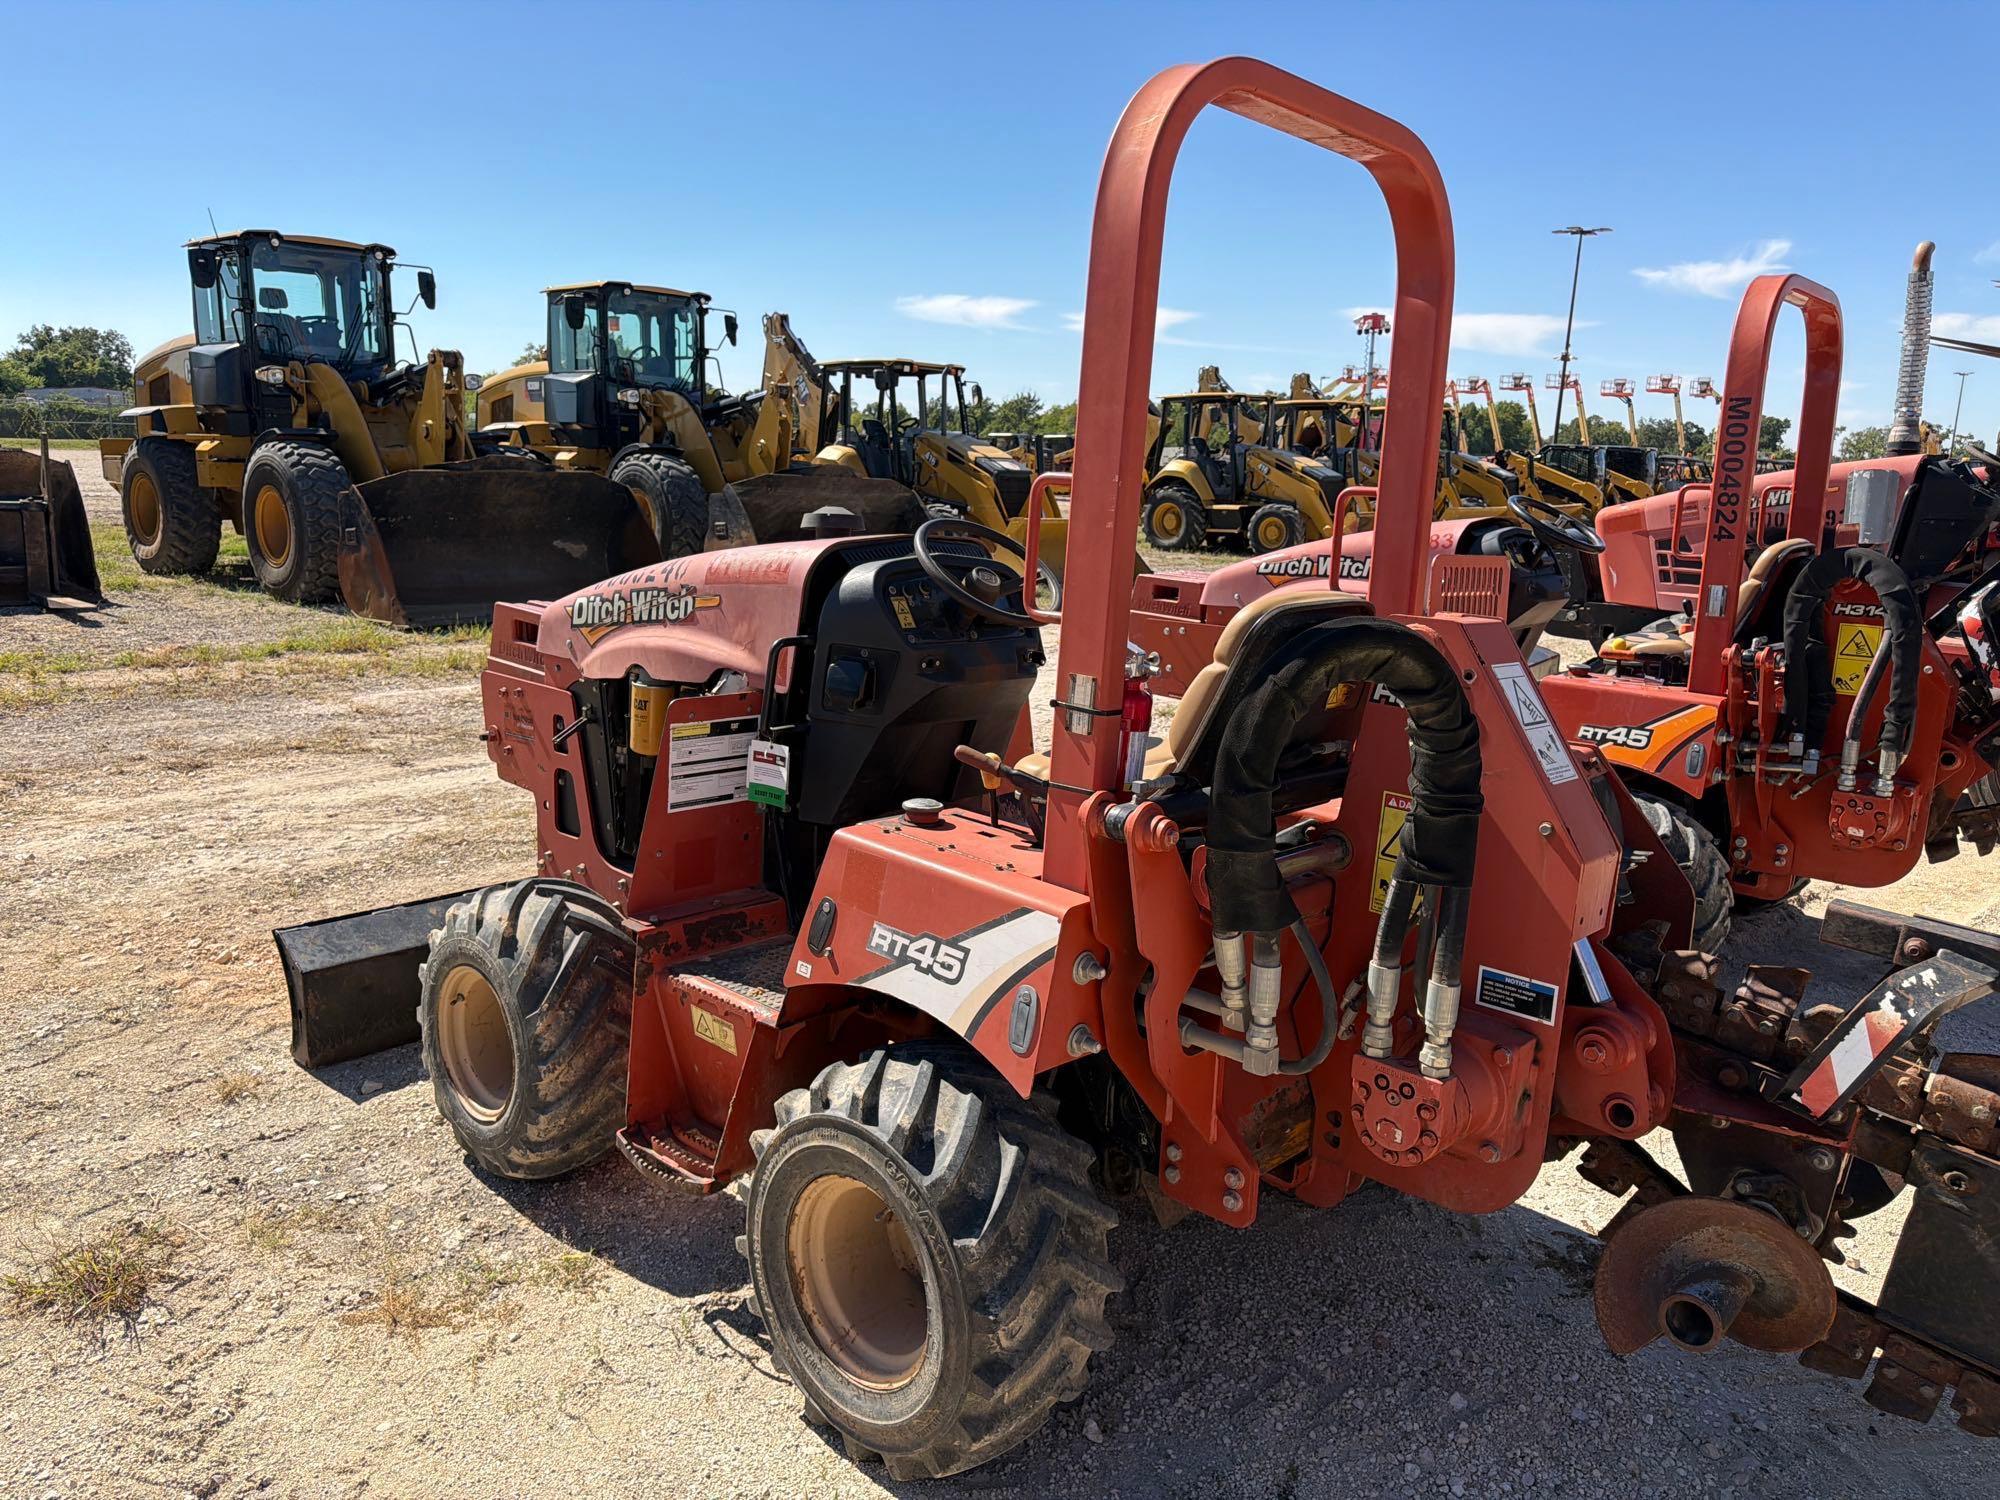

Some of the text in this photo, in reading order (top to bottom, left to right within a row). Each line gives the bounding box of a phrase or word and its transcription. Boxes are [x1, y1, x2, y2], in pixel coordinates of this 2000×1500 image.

[1713, 397, 1752, 542] M0004824
[572, 589, 695, 626] Ditch Witch
[1577, 725, 1651, 747] RT45
[870, 924, 966, 980] RT45
[1504, 977, 1531, 989] NOTICE
